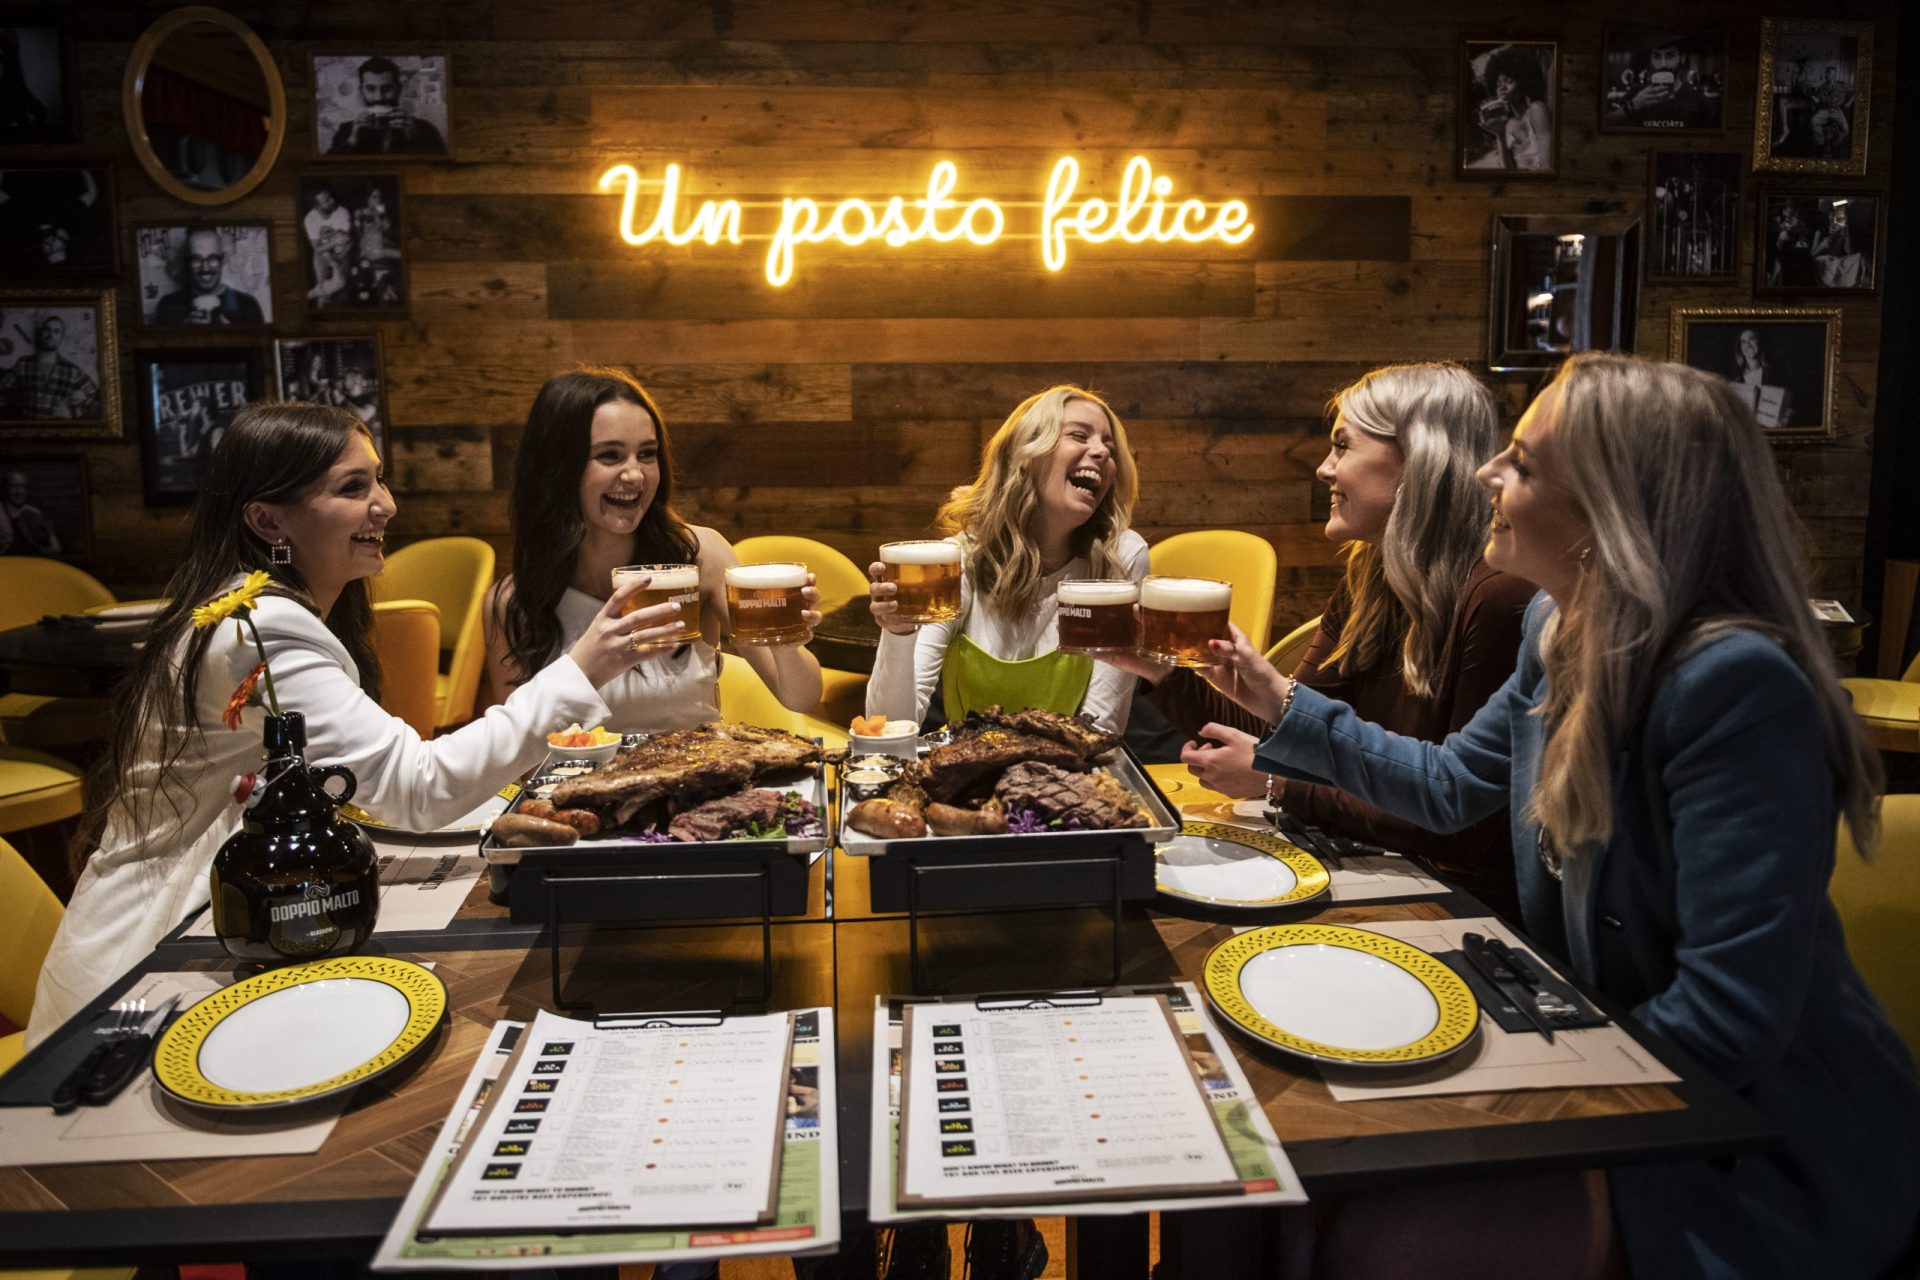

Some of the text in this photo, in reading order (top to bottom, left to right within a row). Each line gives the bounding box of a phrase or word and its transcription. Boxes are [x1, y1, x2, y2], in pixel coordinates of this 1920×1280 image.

[599, 154, 1256, 288] Un posto felice
[763, 597, 787, 608] MALTO
[1070, 607, 1092, 618] MALTO
[270, 890, 360, 923] DOPPIO MALTO
